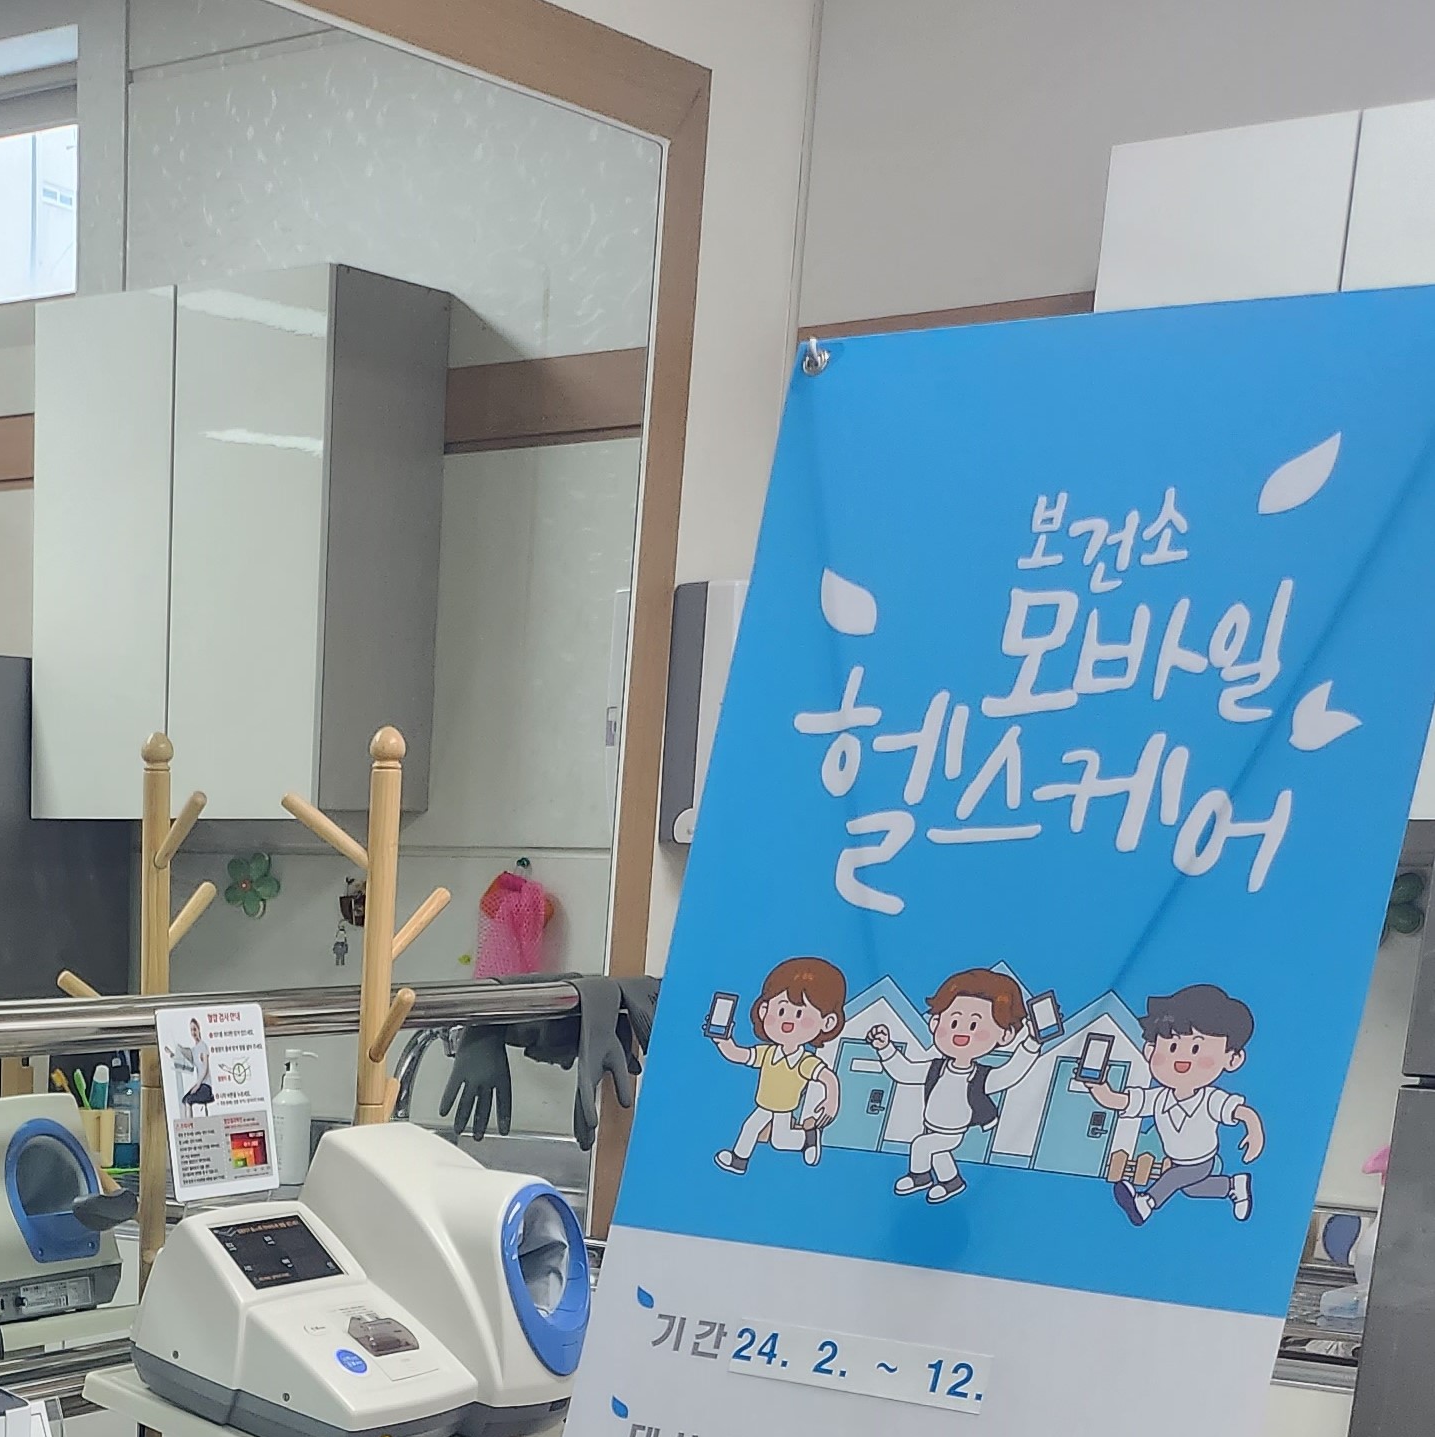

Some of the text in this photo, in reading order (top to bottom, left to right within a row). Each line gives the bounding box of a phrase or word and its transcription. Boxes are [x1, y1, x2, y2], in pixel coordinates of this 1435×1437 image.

[1017, 487, 1188, 592] 보건소
[982, 578, 1293, 722] 모바일
[793, 665, 1293, 916] 헬스케어
[651, 1313, 728, 1359] 기간
[732, 1327, 789, 1368] 24.
[812, 1340, 848, 1378] 2.
[925, 1358, 984, 1402] 12.
